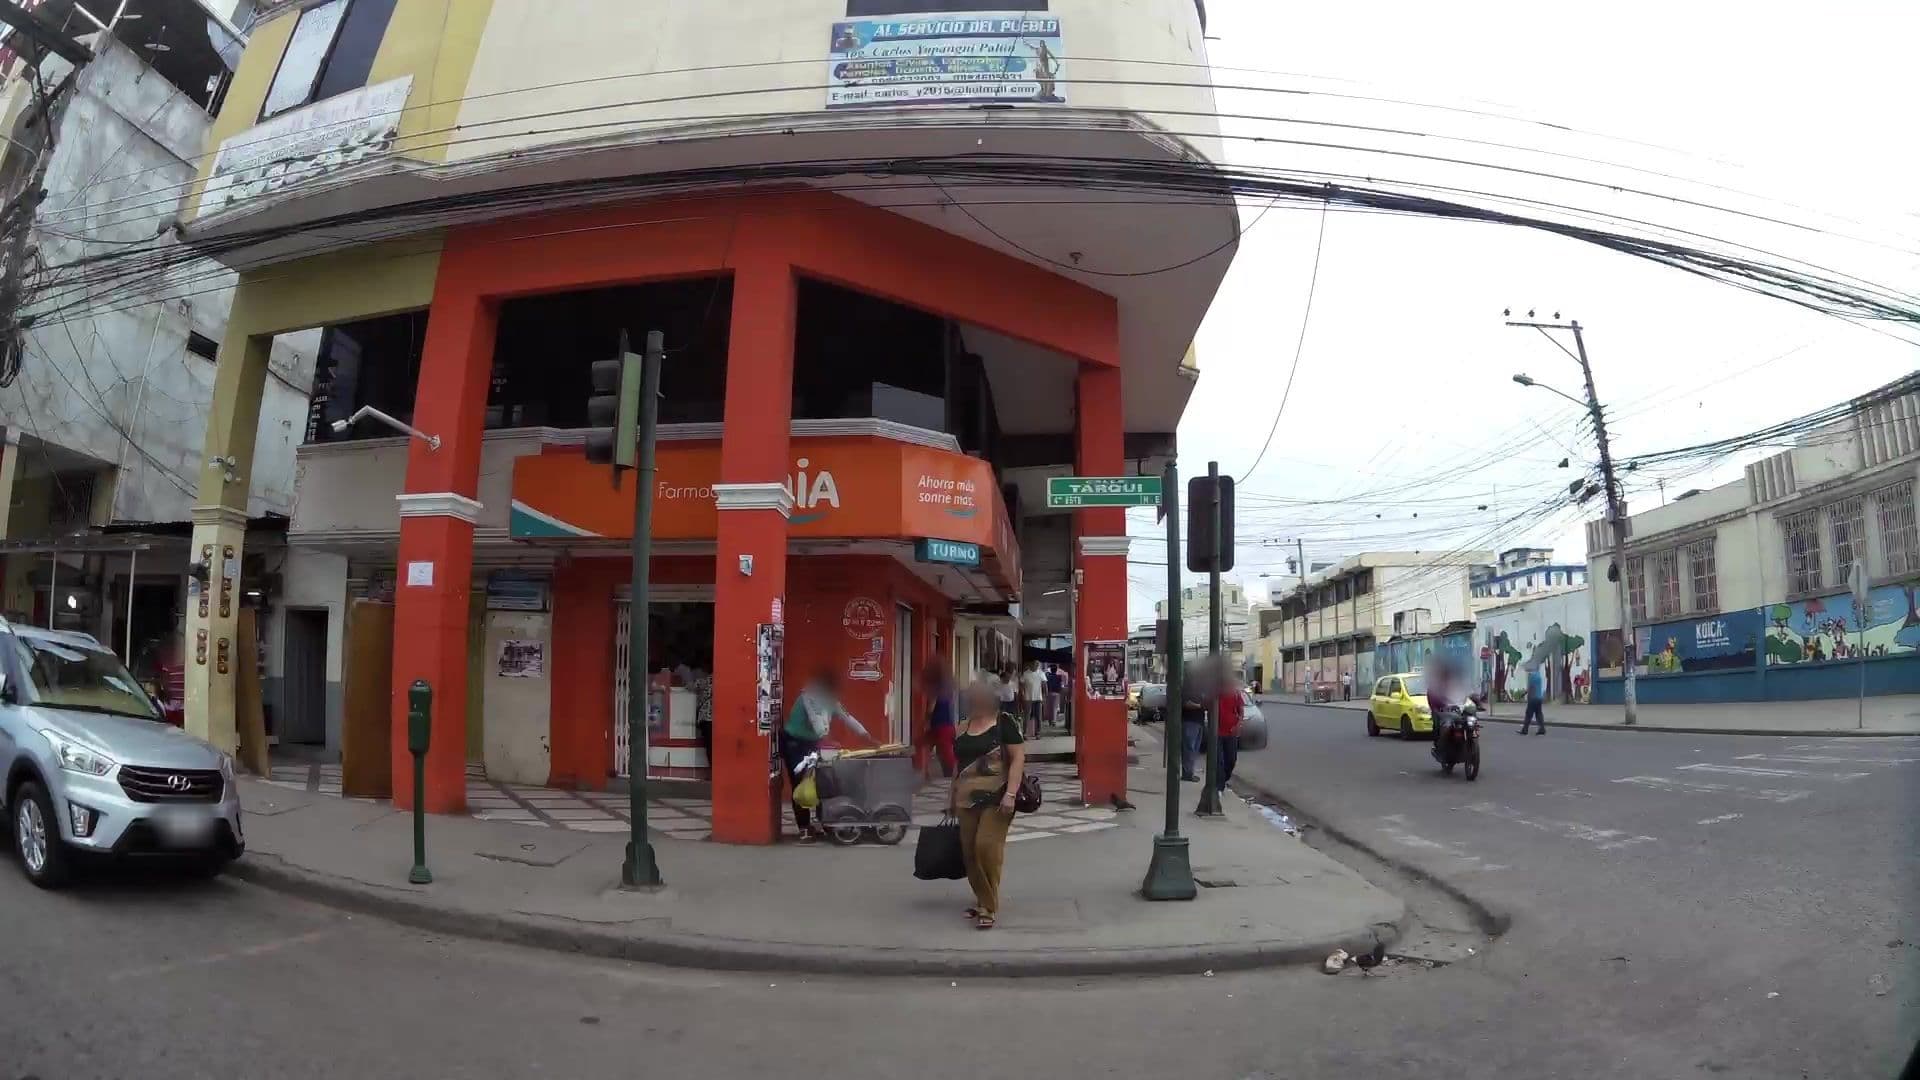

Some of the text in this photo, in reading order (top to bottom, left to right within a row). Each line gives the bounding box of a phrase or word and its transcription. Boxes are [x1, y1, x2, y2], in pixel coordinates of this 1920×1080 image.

[873, 20, 1058, 37] AL SERVICIO DEL PUEBLO
[872, 46, 912, 57] Carlos
[918, 475, 954, 490] Ahorra
[1068, 483, 1143, 493] TARQUI
[932, 543, 977, 561] TURNO
[1696, 621, 1722, 639] KOICA
